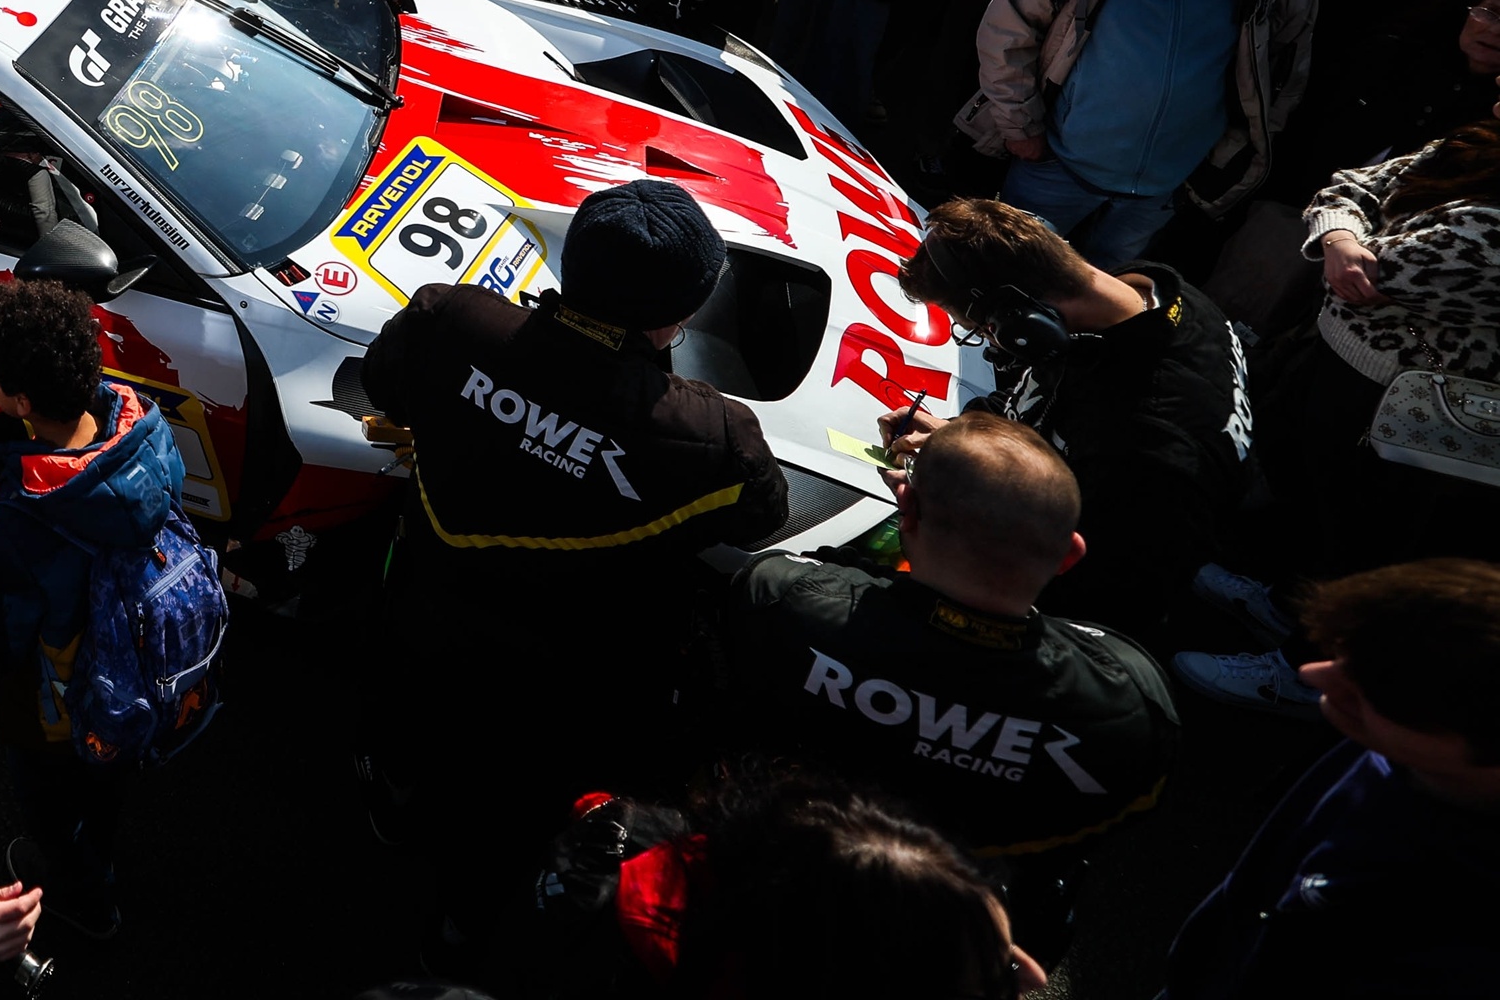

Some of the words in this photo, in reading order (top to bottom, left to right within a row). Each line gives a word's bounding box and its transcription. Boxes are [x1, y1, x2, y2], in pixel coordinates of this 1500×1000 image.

[128, 21, 148, 40] THE
[106, 80, 205, 172] 98
[100, 163, 191, 251] berzerkdesign
[350, 156, 432, 239] RAVENOL
[399, 196, 488, 271] 98
[322, 267, 350, 290] E
[511, 242, 533, 269] RAVENOL
[783, 100, 952, 412] ROWE
[315, 303, 338, 321] N
[460, 364, 604, 461] ROWE
[518, 436, 587, 481] RACING
[803, 646, 1043, 767] ROWE
[911, 740, 1027, 784] RACING
